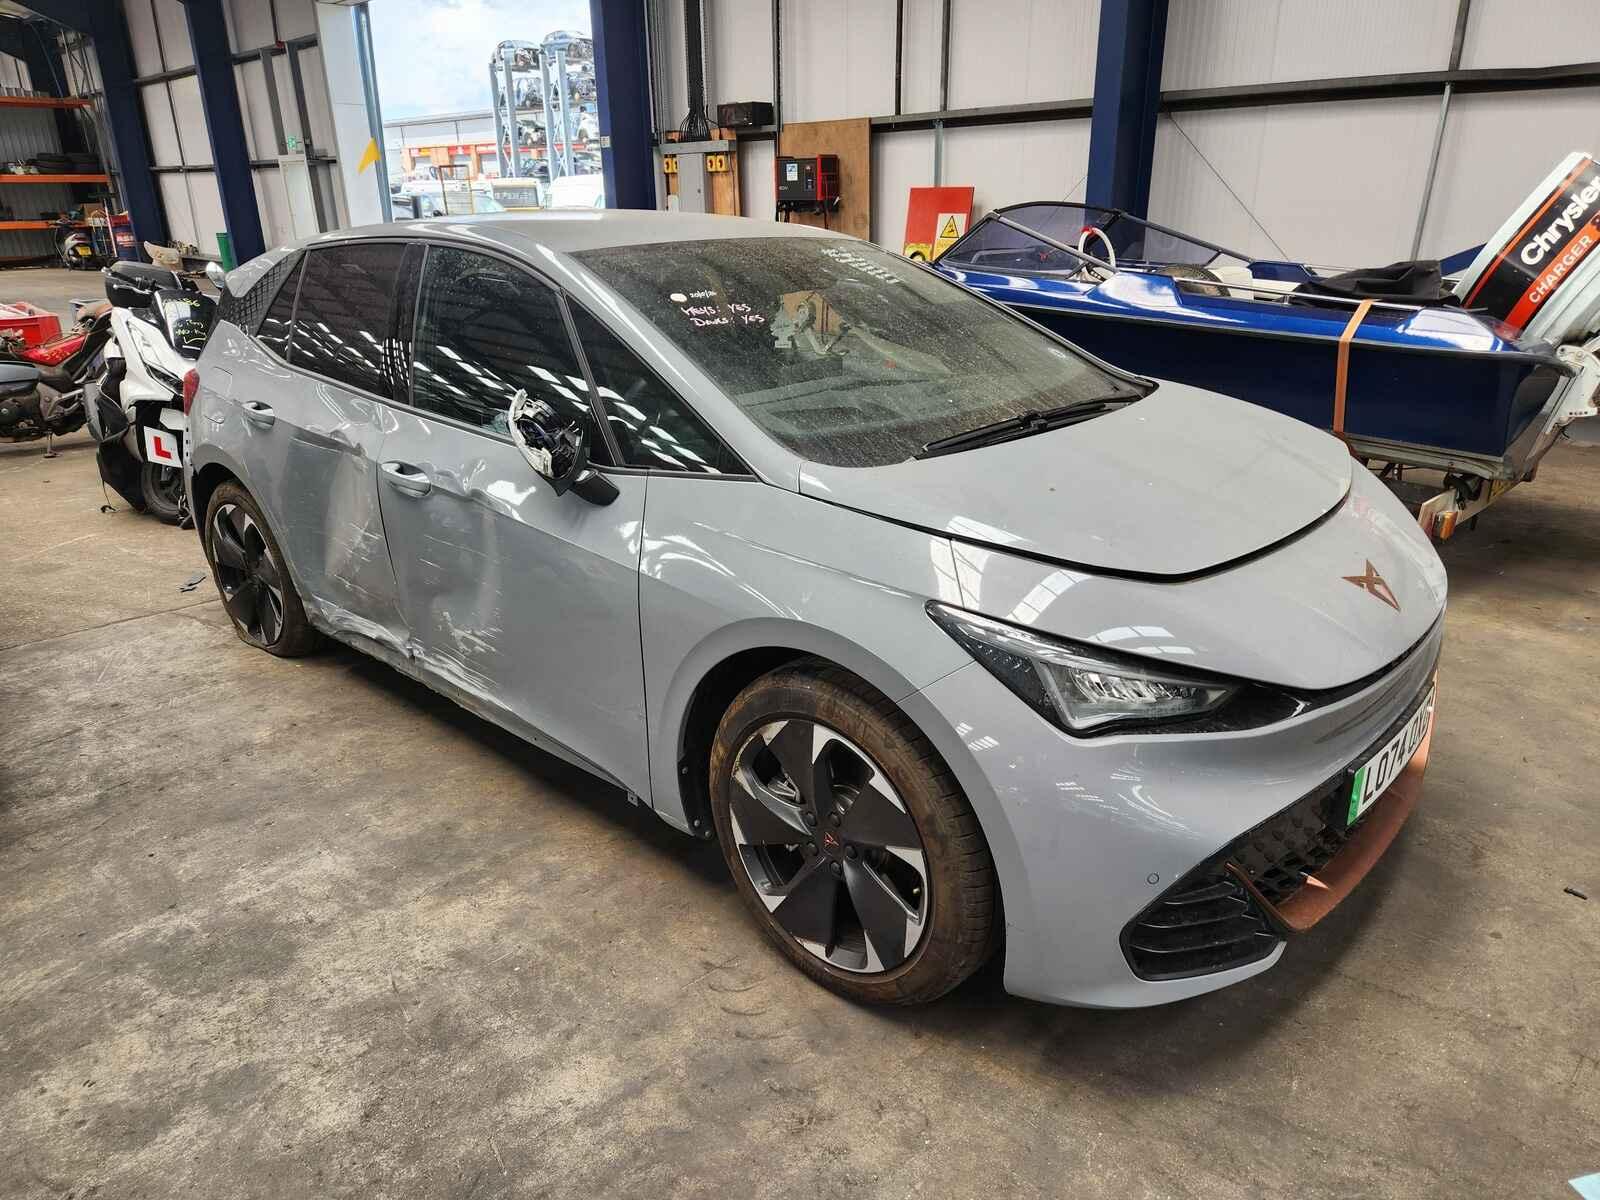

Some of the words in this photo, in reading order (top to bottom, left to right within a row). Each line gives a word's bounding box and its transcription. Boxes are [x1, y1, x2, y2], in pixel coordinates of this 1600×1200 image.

[1520, 175, 1600, 265] Chrysler
[1528, 234, 1592, 304] CHARGER
[727, 303, 752, 314] YES
[741, 314, 765, 325] YES
[153, 435, 172, 460] L
